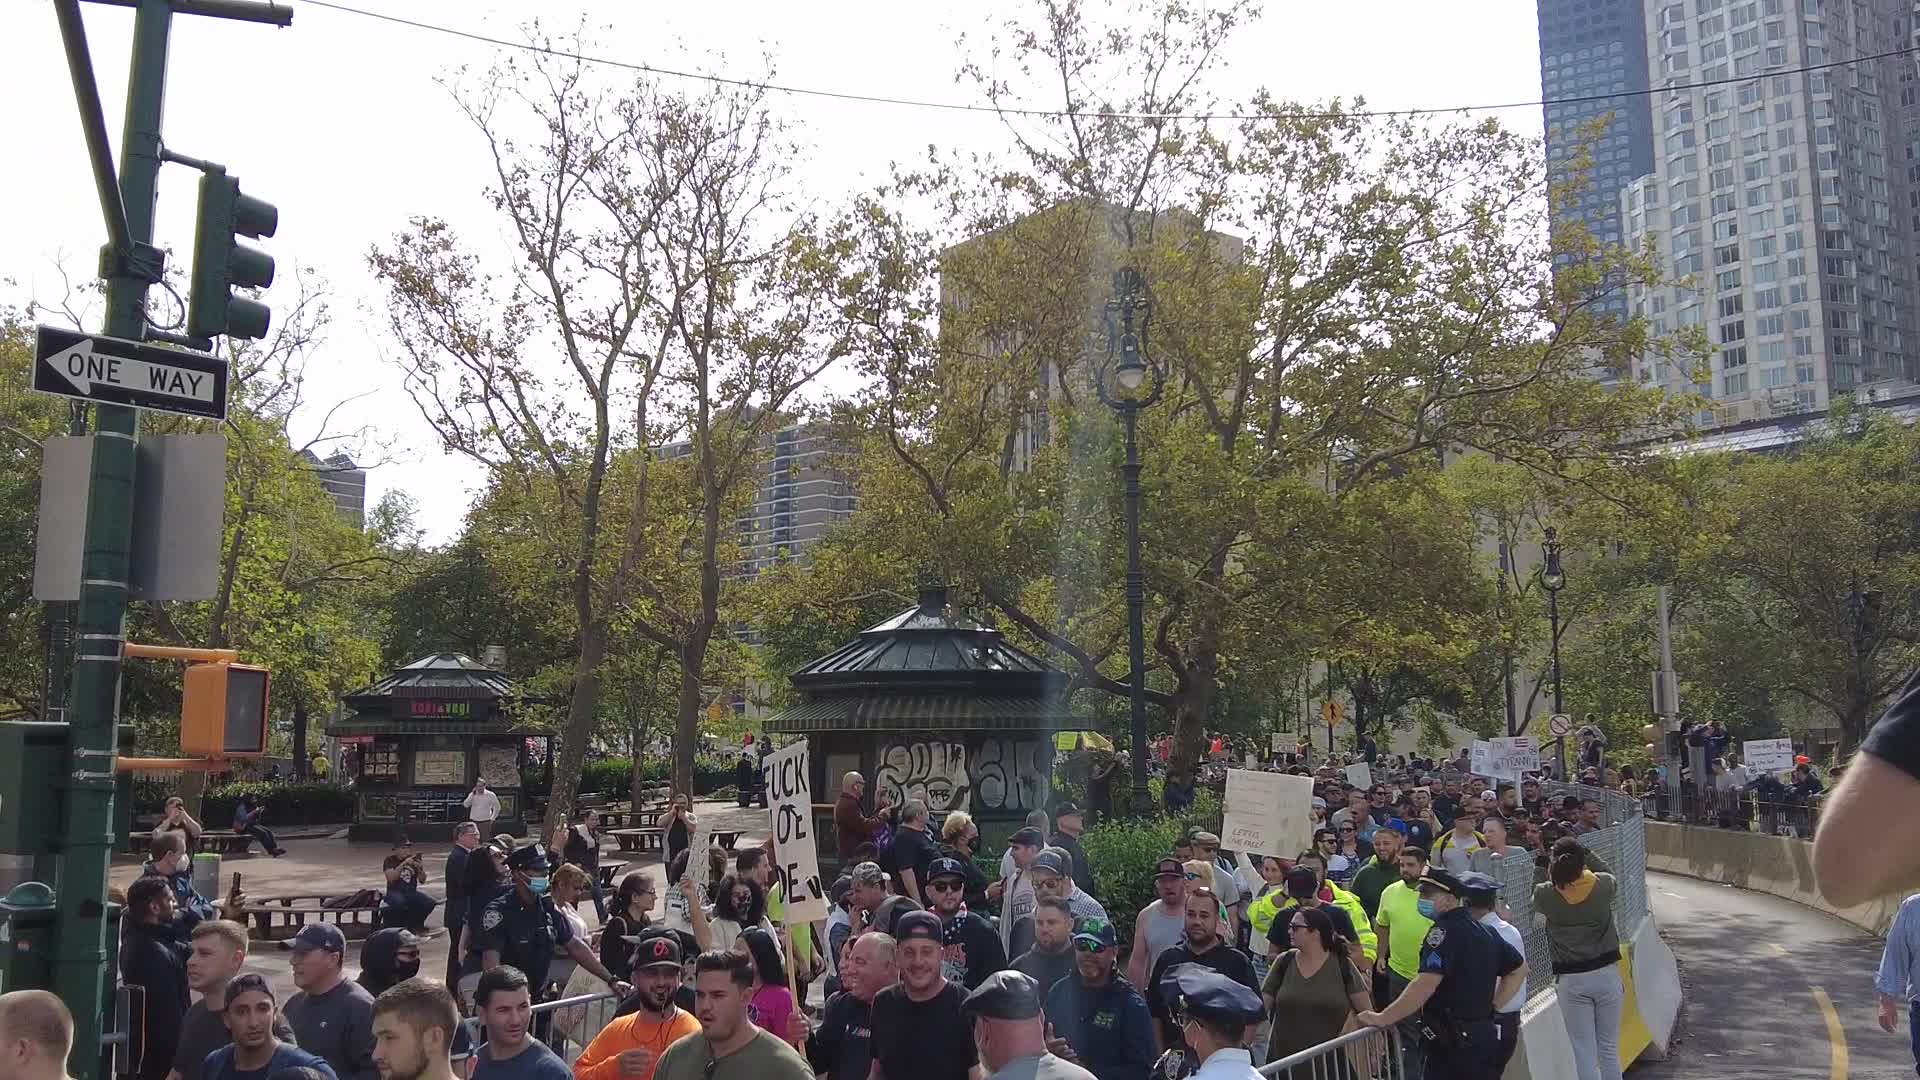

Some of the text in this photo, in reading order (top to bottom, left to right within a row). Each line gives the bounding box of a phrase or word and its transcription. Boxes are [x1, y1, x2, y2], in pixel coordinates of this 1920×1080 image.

[67, 352, 203, 397] ONE WAY
[763, 753, 808, 801] FUCK
